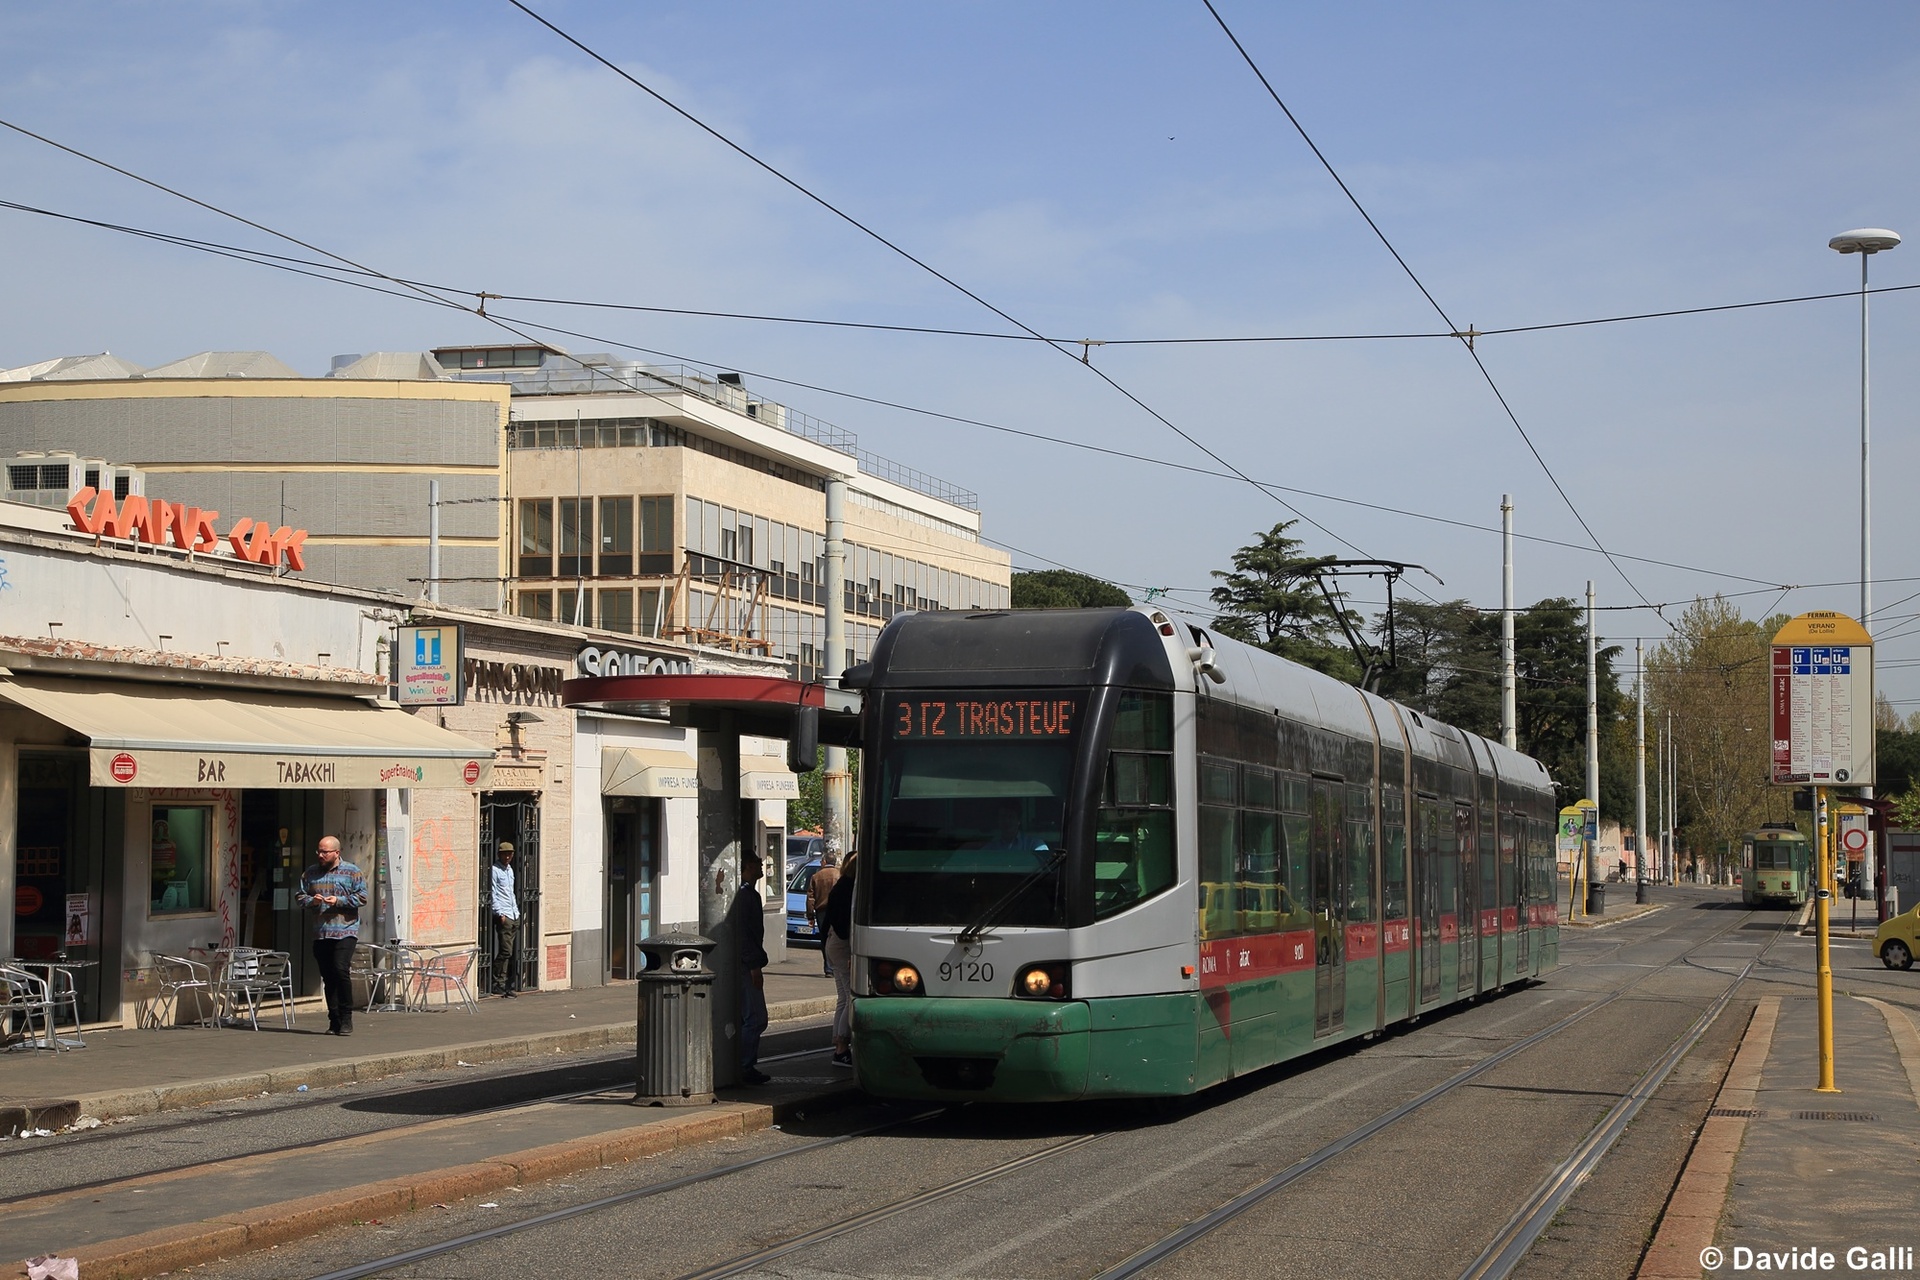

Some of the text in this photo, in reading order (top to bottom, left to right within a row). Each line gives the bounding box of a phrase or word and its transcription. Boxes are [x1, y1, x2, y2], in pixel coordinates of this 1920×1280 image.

[67, 486, 219, 553] CAMPUS
[418, 630, 439, 663] T
[1794, 666, 1799, 674] 2
[1814, 666, 1818, 674] 3
[1833, 666, 1842, 674] 19
[956, 701, 1075, 735] TRASTEVE
[198, 758, 226, 782] BAR
[277, 761, 335, 783] TABACCHI
[379, 763, 418, 783] SuperEnalotto
[658, 777, 679, 788] IMPRESA
[757, 780, 795, 791] IMPRESA FUNEBRE
[1202, 948, 1250, 974] ROMA atac
[1294, 943, 1304, 960] 9120
[940, 962, 995, 982] 9120
